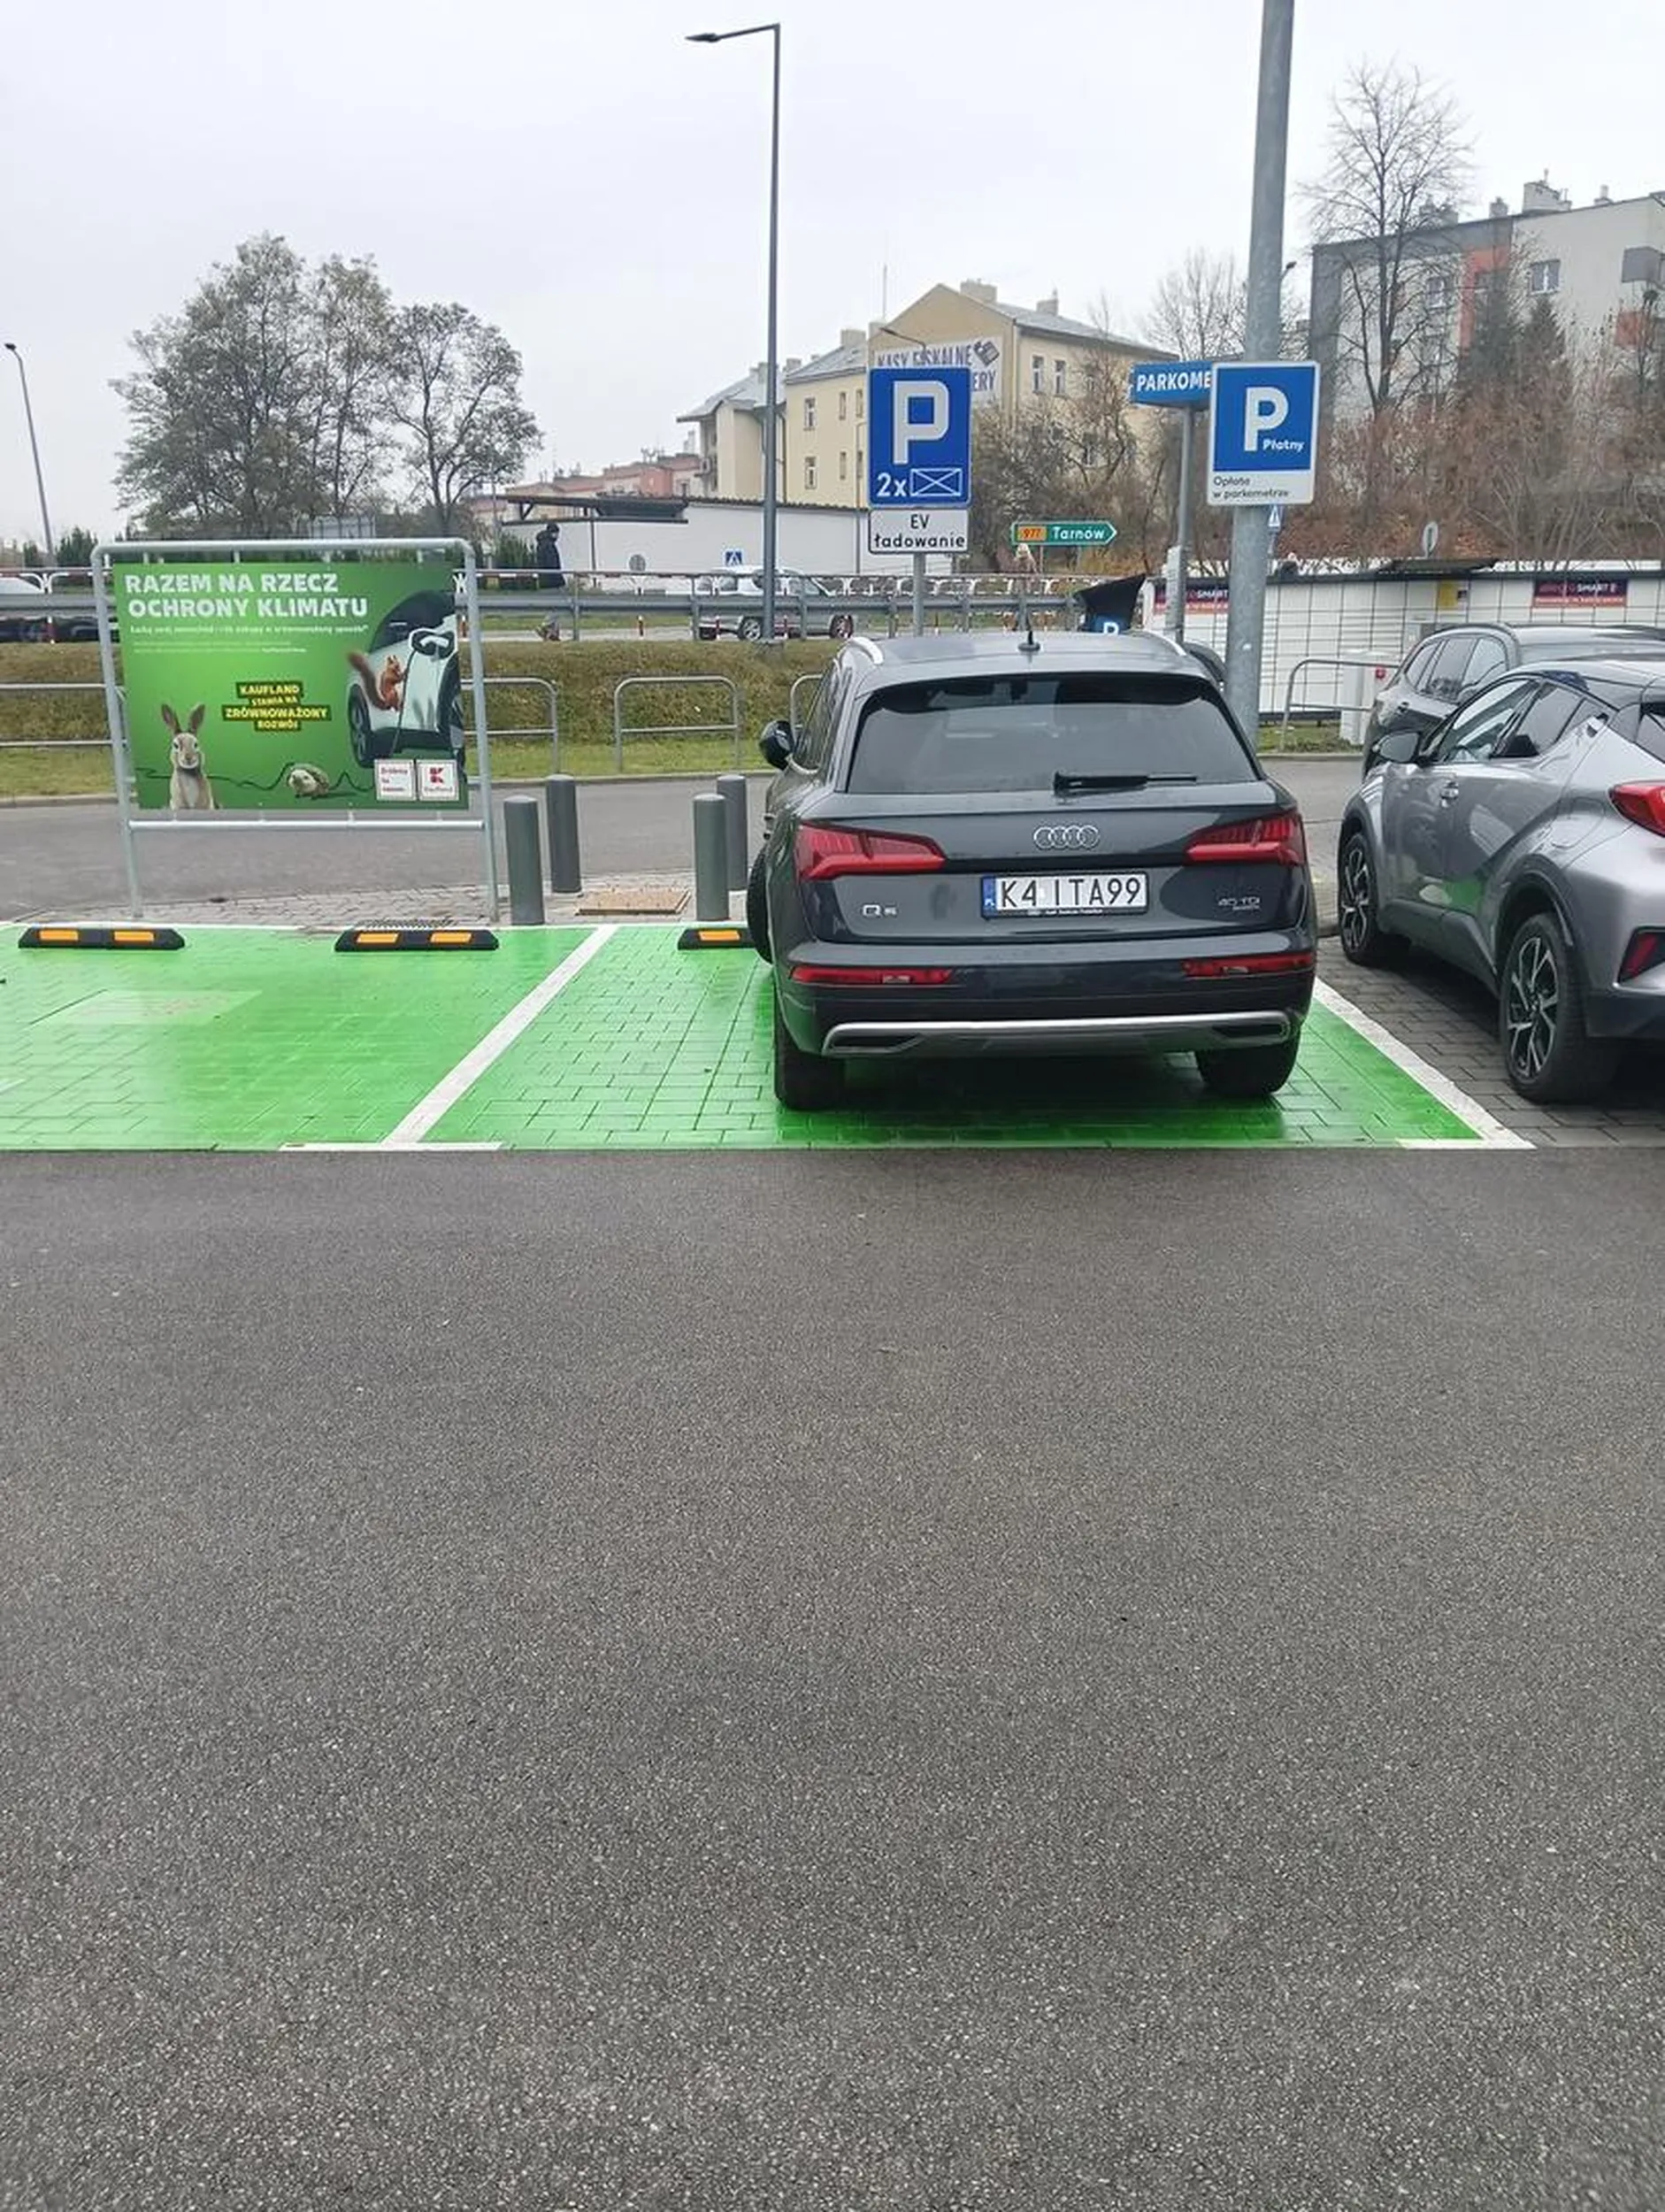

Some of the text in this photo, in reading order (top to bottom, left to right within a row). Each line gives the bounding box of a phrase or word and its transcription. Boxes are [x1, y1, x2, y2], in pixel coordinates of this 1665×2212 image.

[893, 380, 949, 465] P
[1244, 386, 1289, 452] P
[1262, 438, 1305, 452] Płatny
[909, 513, 931, 529] EV
[873, 533, 966, 549] ładowanie
[1052, 526, 1105, 540] Tarnów
[125, 572, 339, 593] RAZEM NA RZECZ
[128, 597, 368, 618] OCHRONY KLIMATU
[239, 684, 300, 695] KAUFLAND
